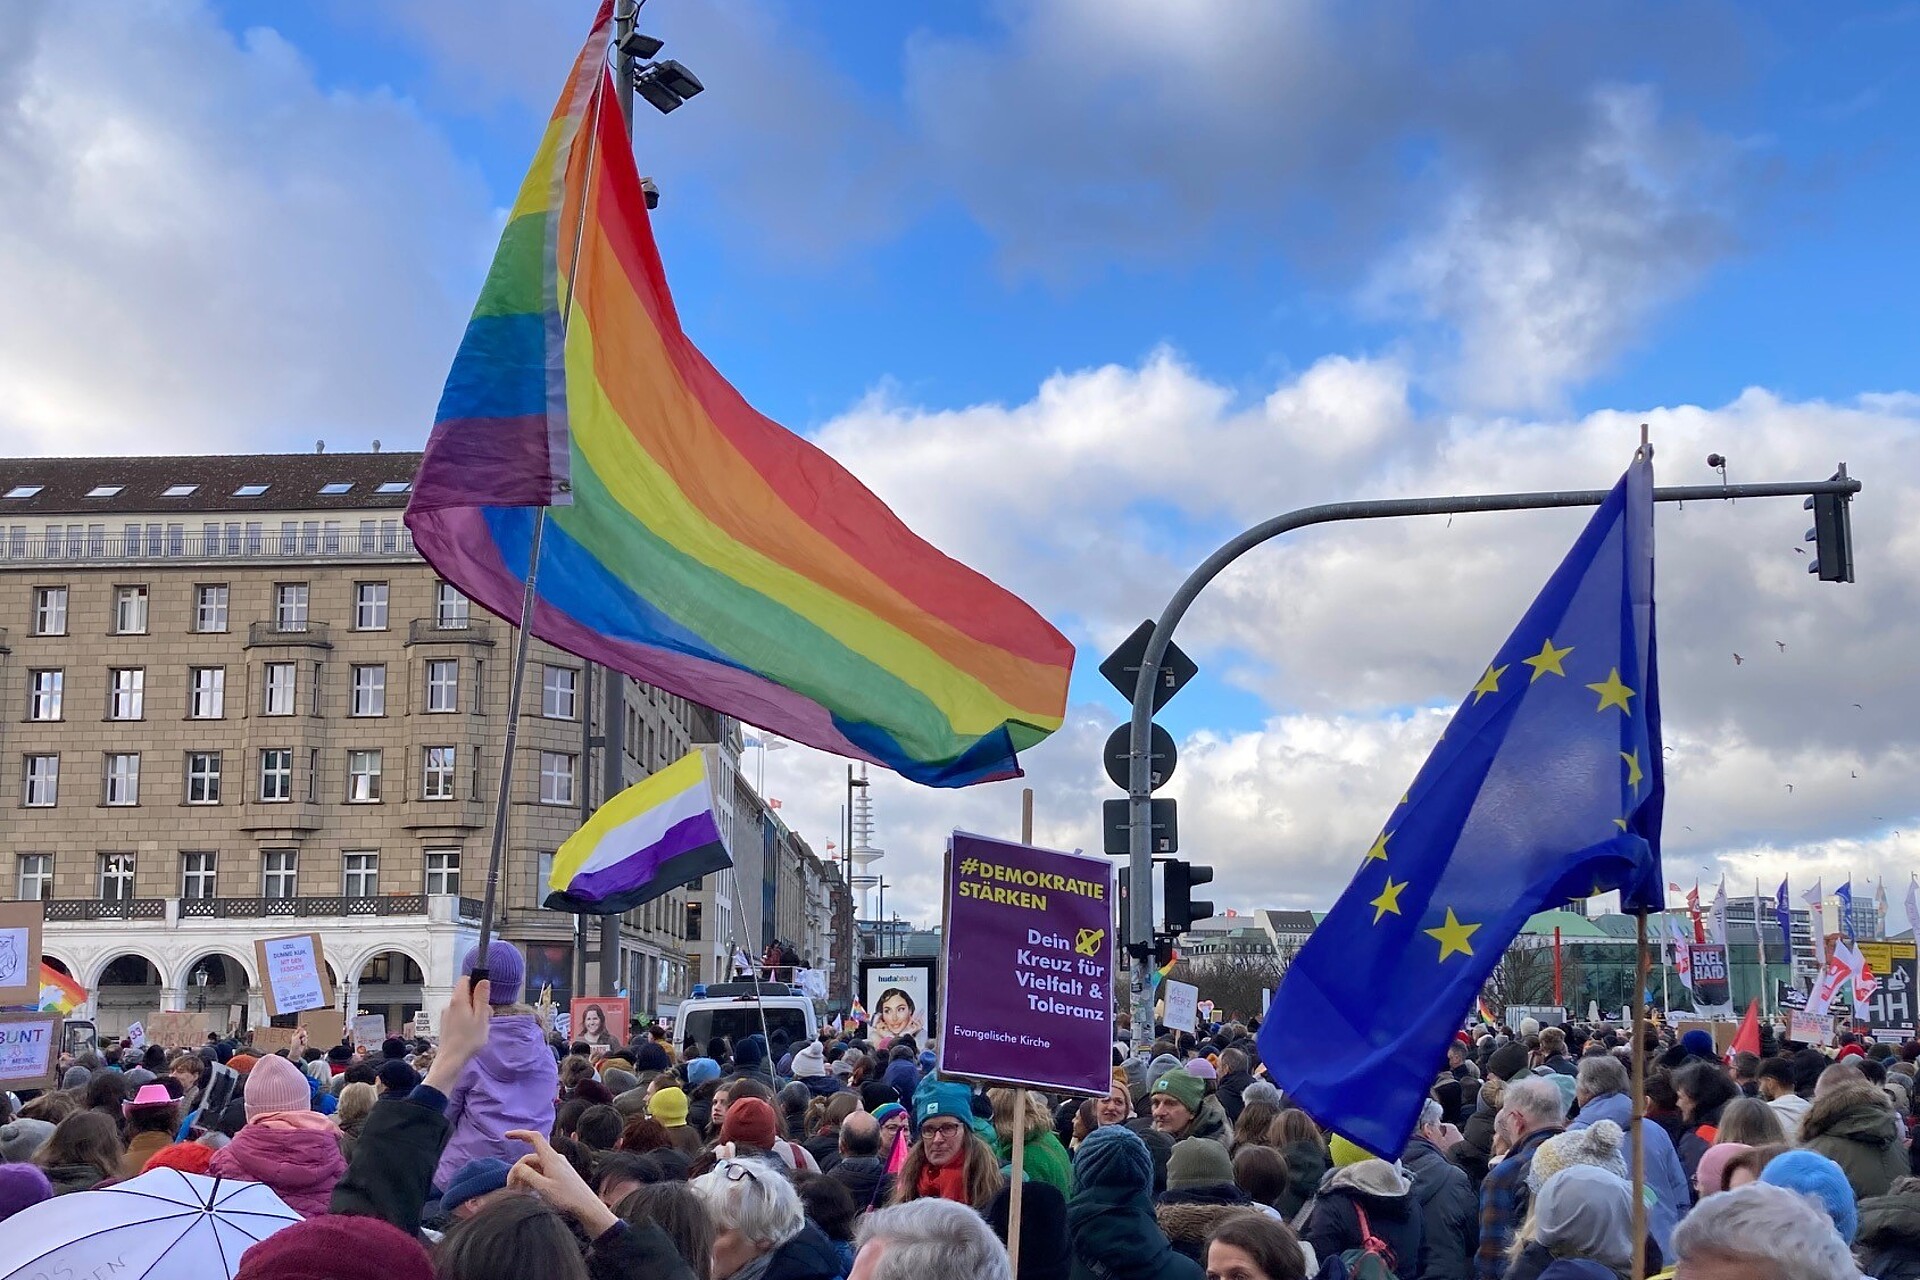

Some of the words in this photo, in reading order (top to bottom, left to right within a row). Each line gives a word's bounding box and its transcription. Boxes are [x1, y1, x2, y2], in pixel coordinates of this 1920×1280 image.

[959, 857, 1104, 900] #DEMOKRATIE
[959, 881, 1047, 911] STÄRKEN
[1028, 928, 1070, 951] Dein
[1017, 949, 1072, 973] Kreuz
[1078, 959, 1105, 977] für
[1692, 951, 1723, 965] EKEL
[1015, 971, 1083, 996] Vielfalt
[1089, 983, 1104, 999] &
[1028, 994, 1105, 1021] Toleranz
[954, 1025, 1018, 1043] Evangelische
[1020, 1035, 1051, 1048] Kirche
